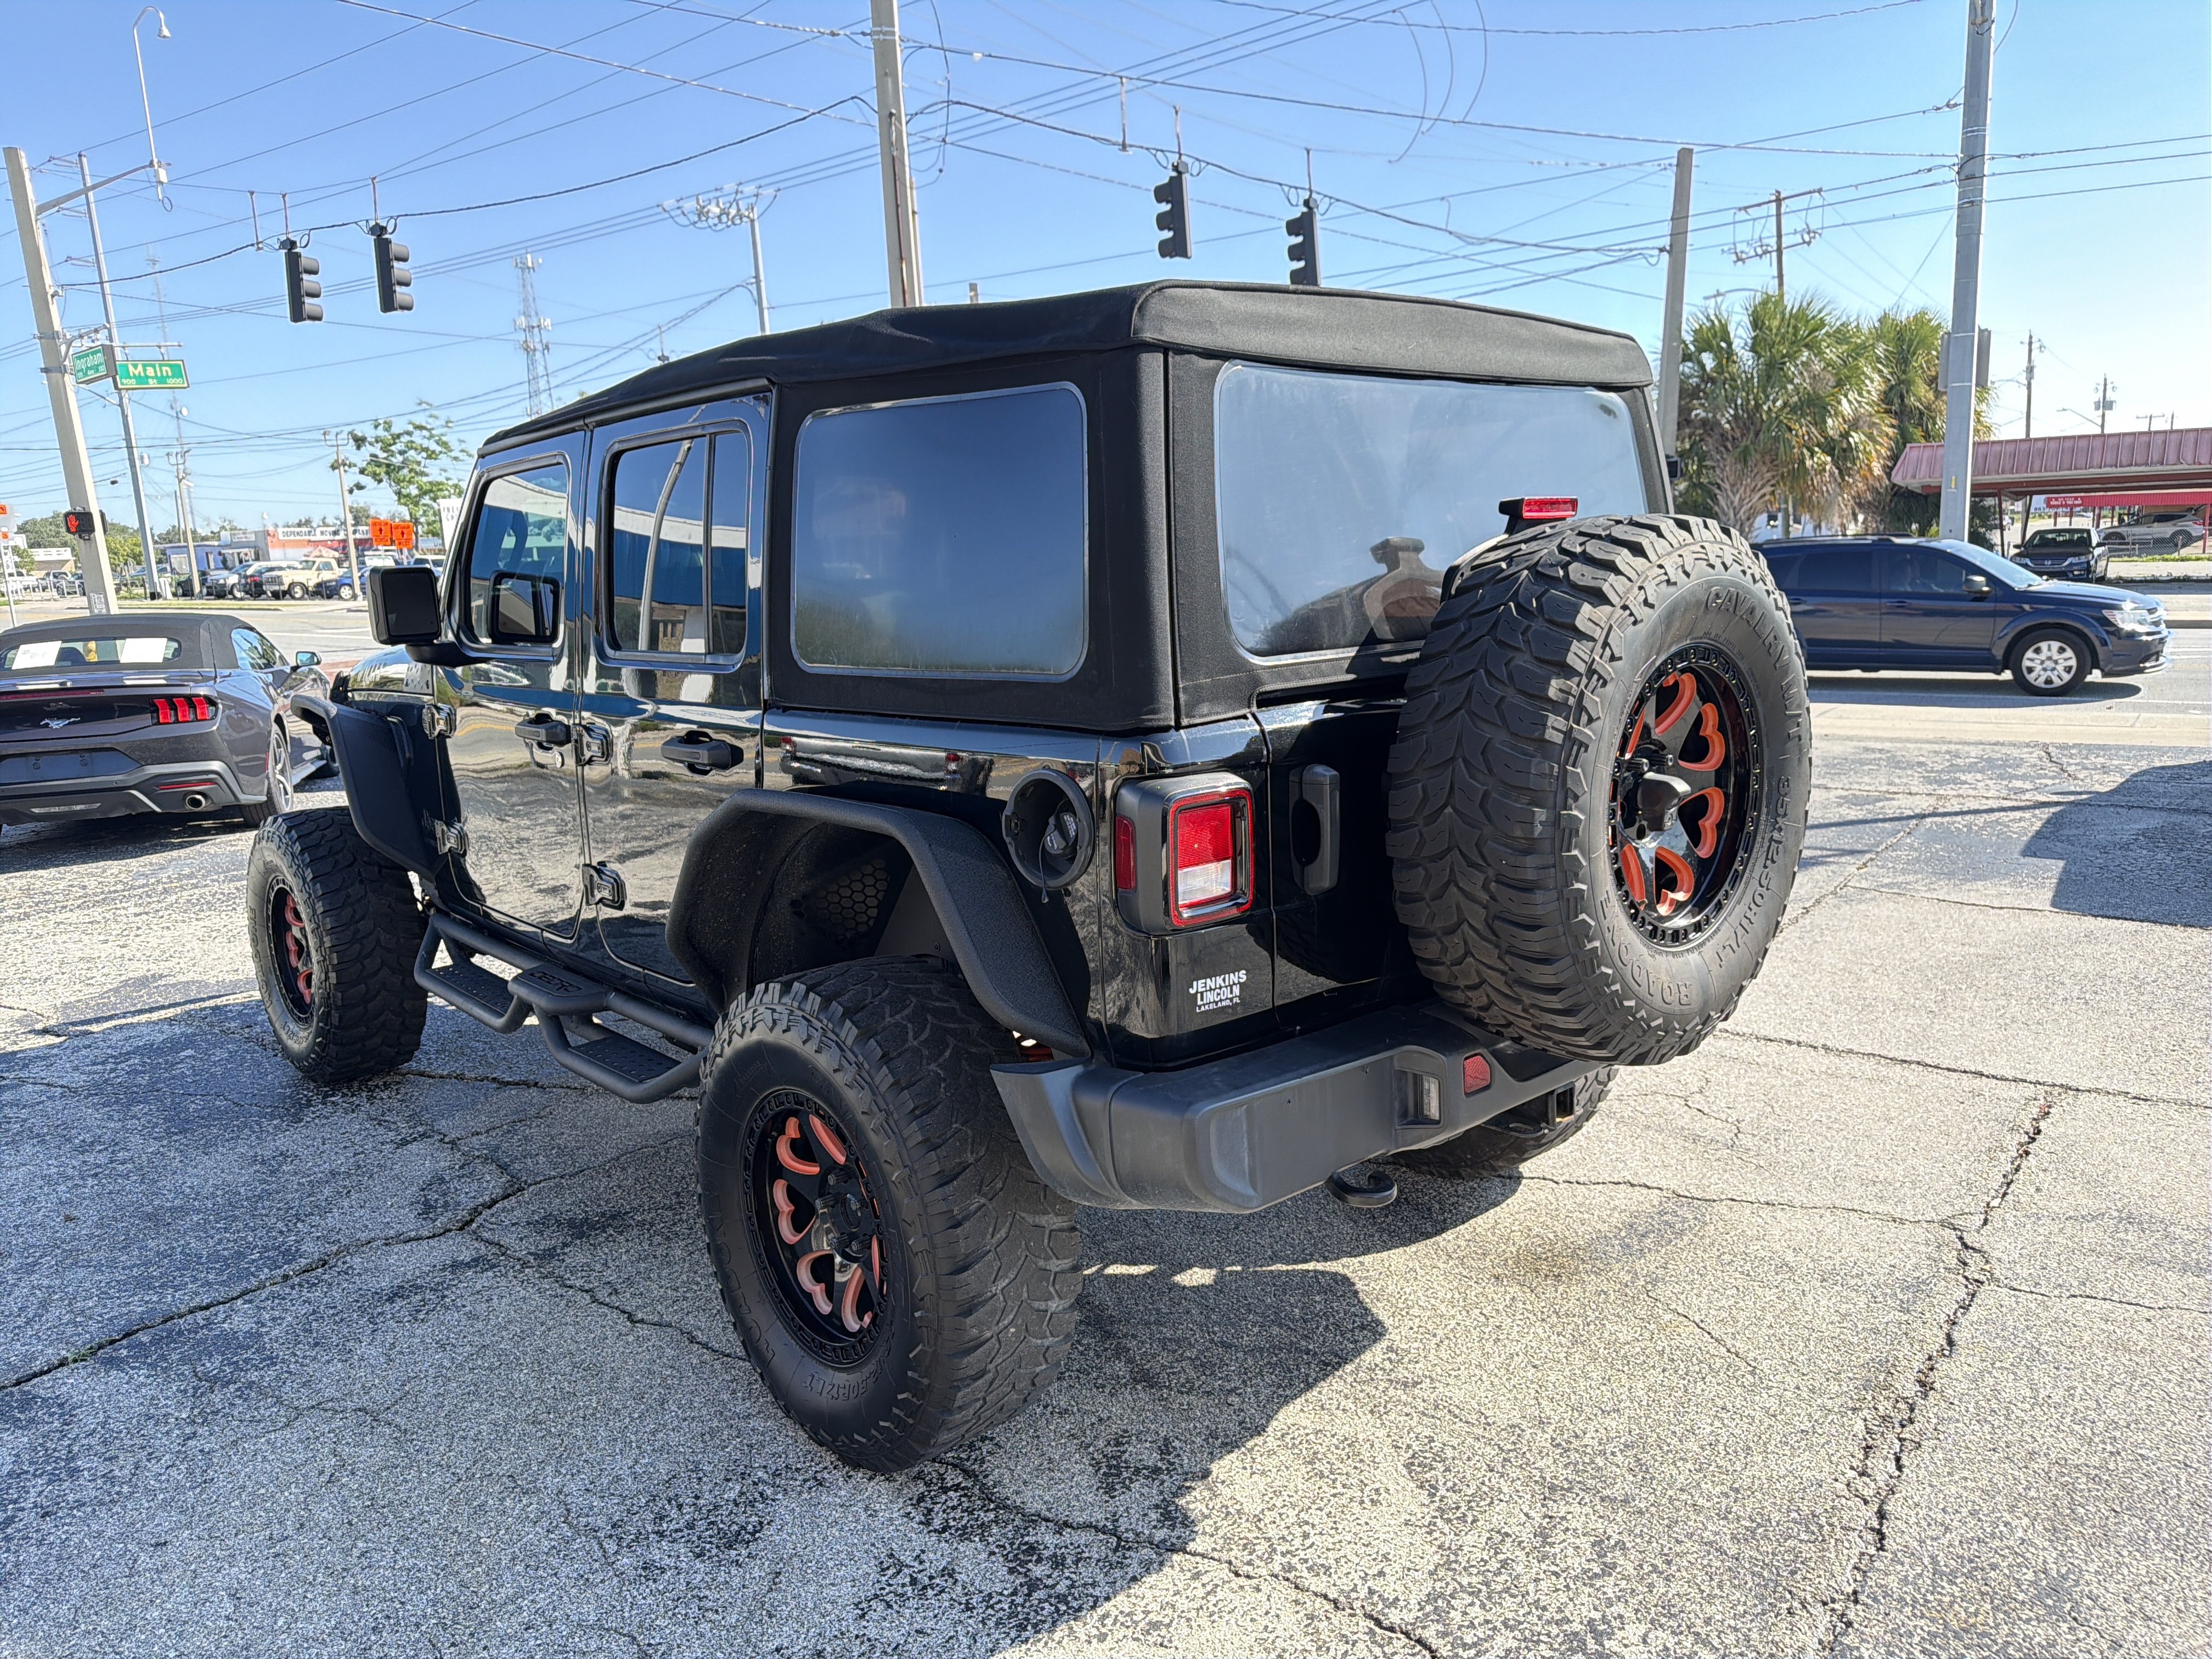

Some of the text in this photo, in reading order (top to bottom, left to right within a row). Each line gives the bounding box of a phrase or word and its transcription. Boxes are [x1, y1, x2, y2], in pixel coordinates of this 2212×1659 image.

[75, 353, 103, 373] Ingraham
[128, 364, 172, 377] Main
[1705, 586, 1790, 670] CAVALRY
[1188, 969, 1247, 994] JENKINS
[1197, 984, 1240, 1006] LINCOLN
[1196, 999, 1232, 1013] LAKELAND,
